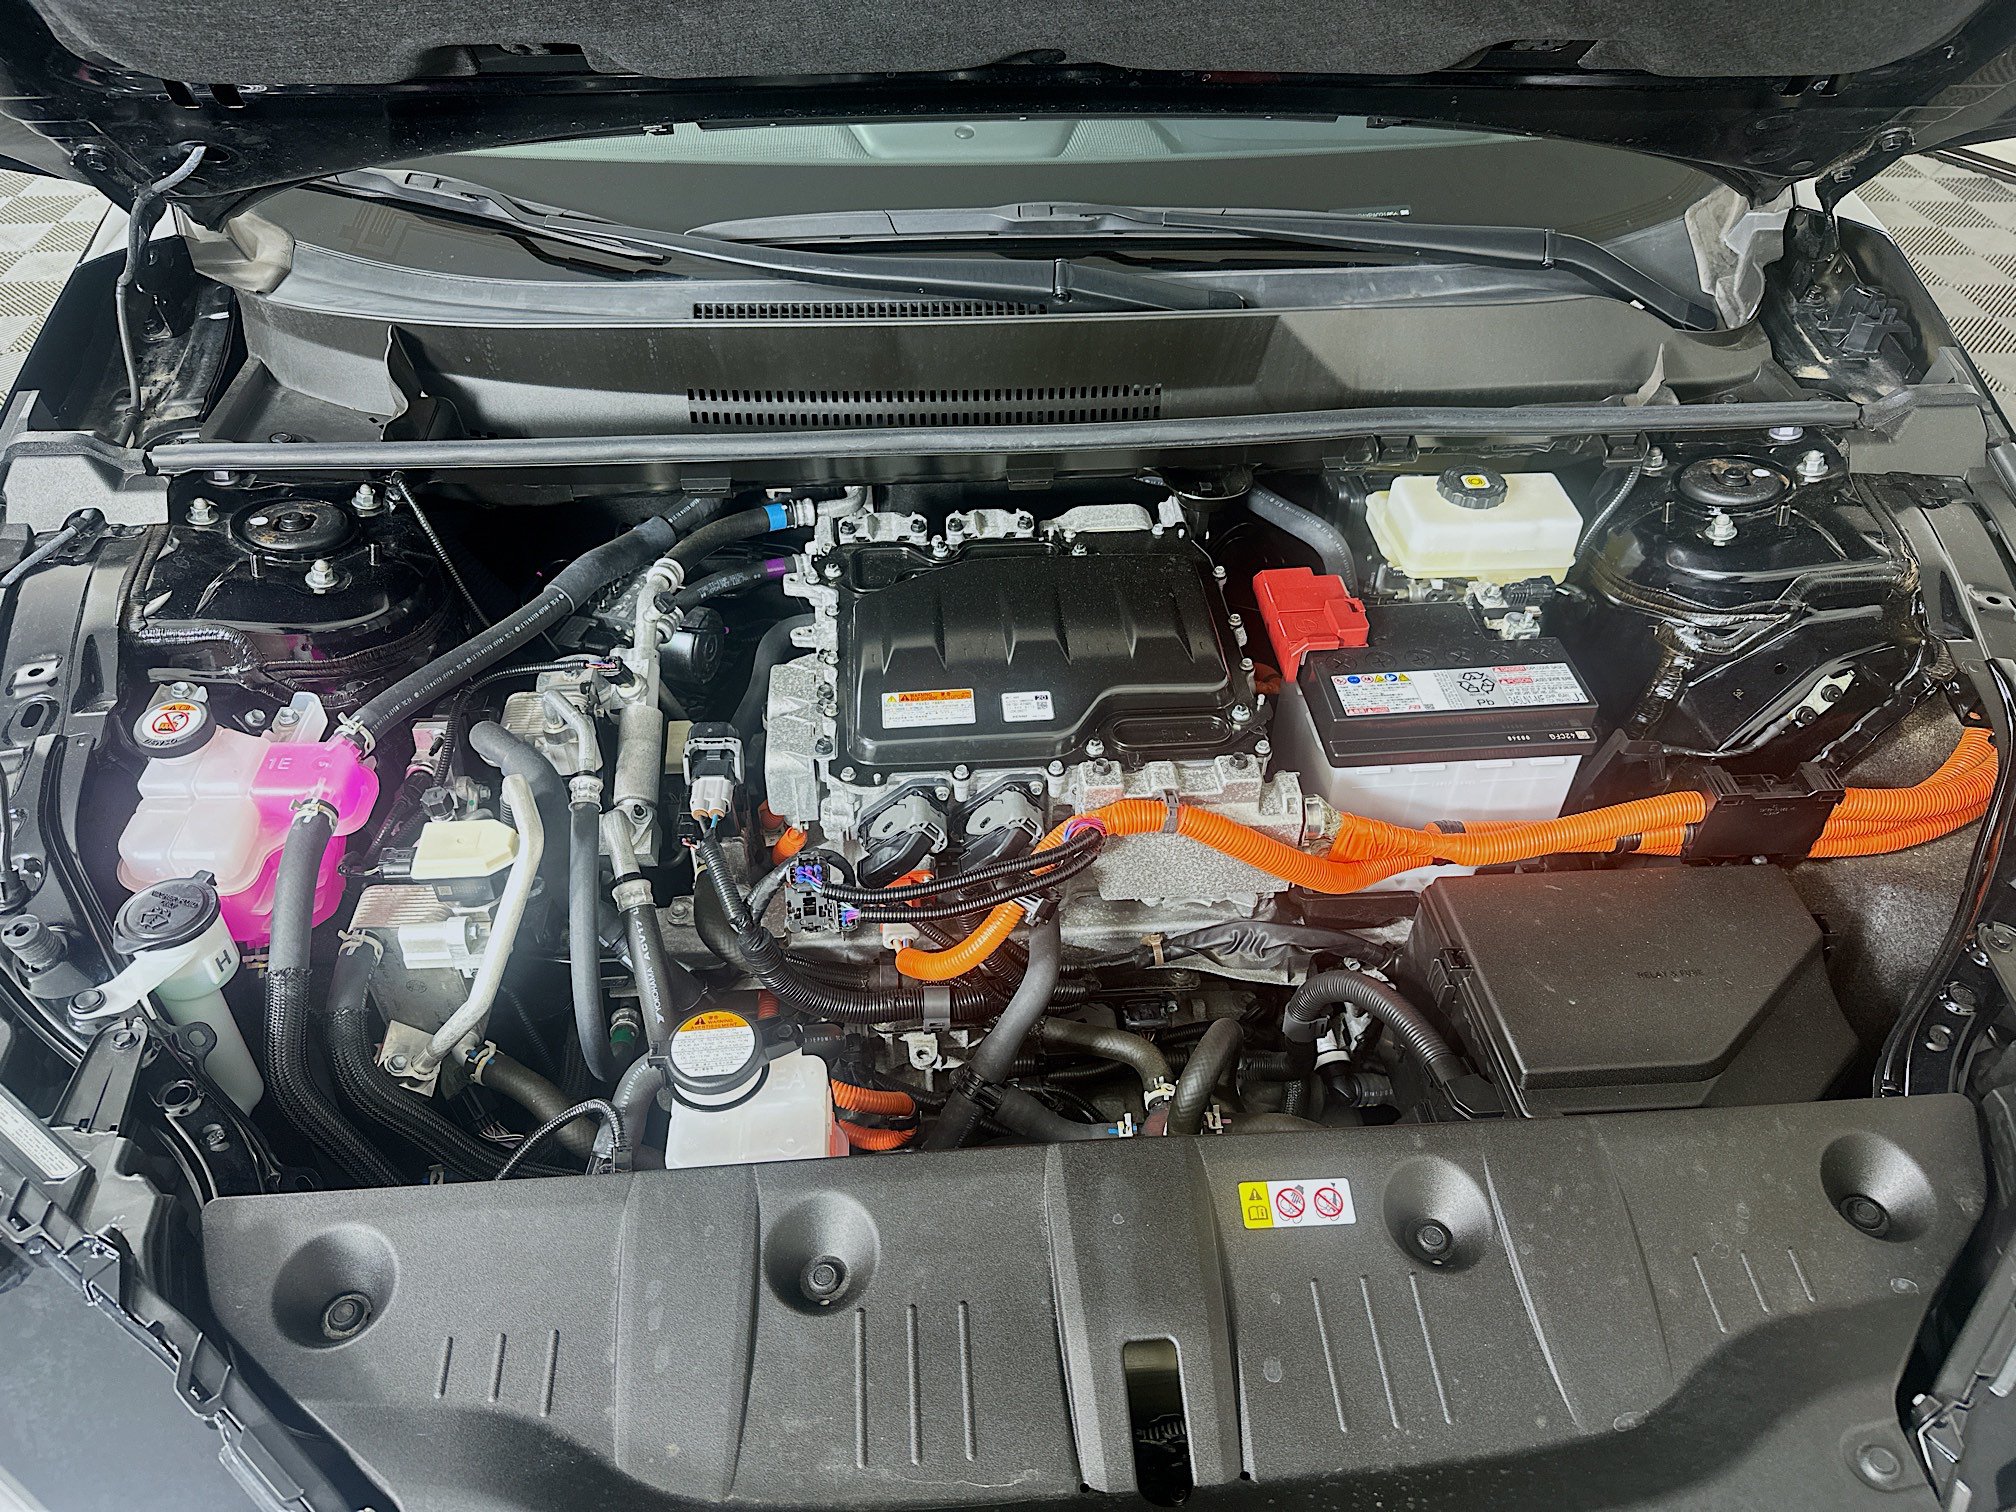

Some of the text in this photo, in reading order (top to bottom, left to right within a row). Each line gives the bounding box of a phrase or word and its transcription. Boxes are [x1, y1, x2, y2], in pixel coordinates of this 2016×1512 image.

[1477, 698, 1495, 706] Pb
[215, 949, 231, 972] H
[647, 966, 662, 1011] YOKOHAMA
